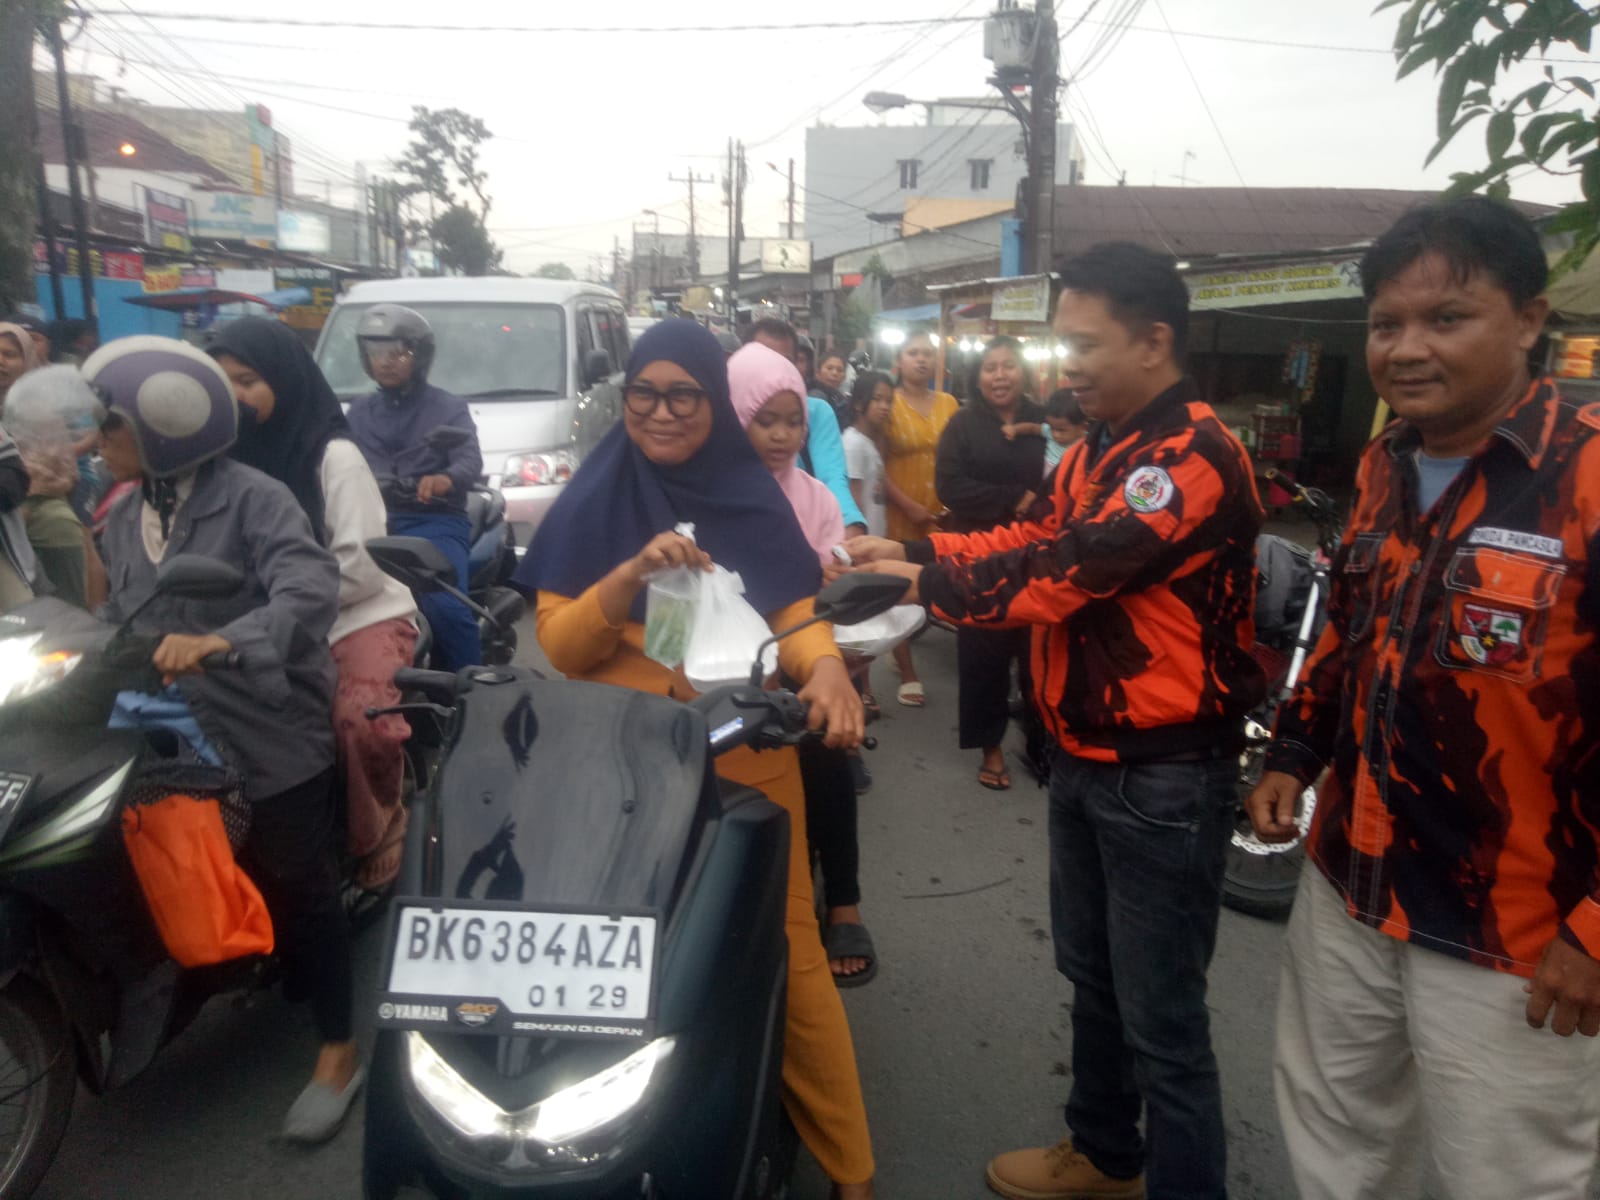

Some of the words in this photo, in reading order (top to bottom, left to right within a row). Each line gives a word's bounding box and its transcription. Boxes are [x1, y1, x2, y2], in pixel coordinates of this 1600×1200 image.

[528, 985, 567, 1008] 01
[588, 985, 628, 1008] 29
[394, 1003, 449, 1021] YAMAHA
